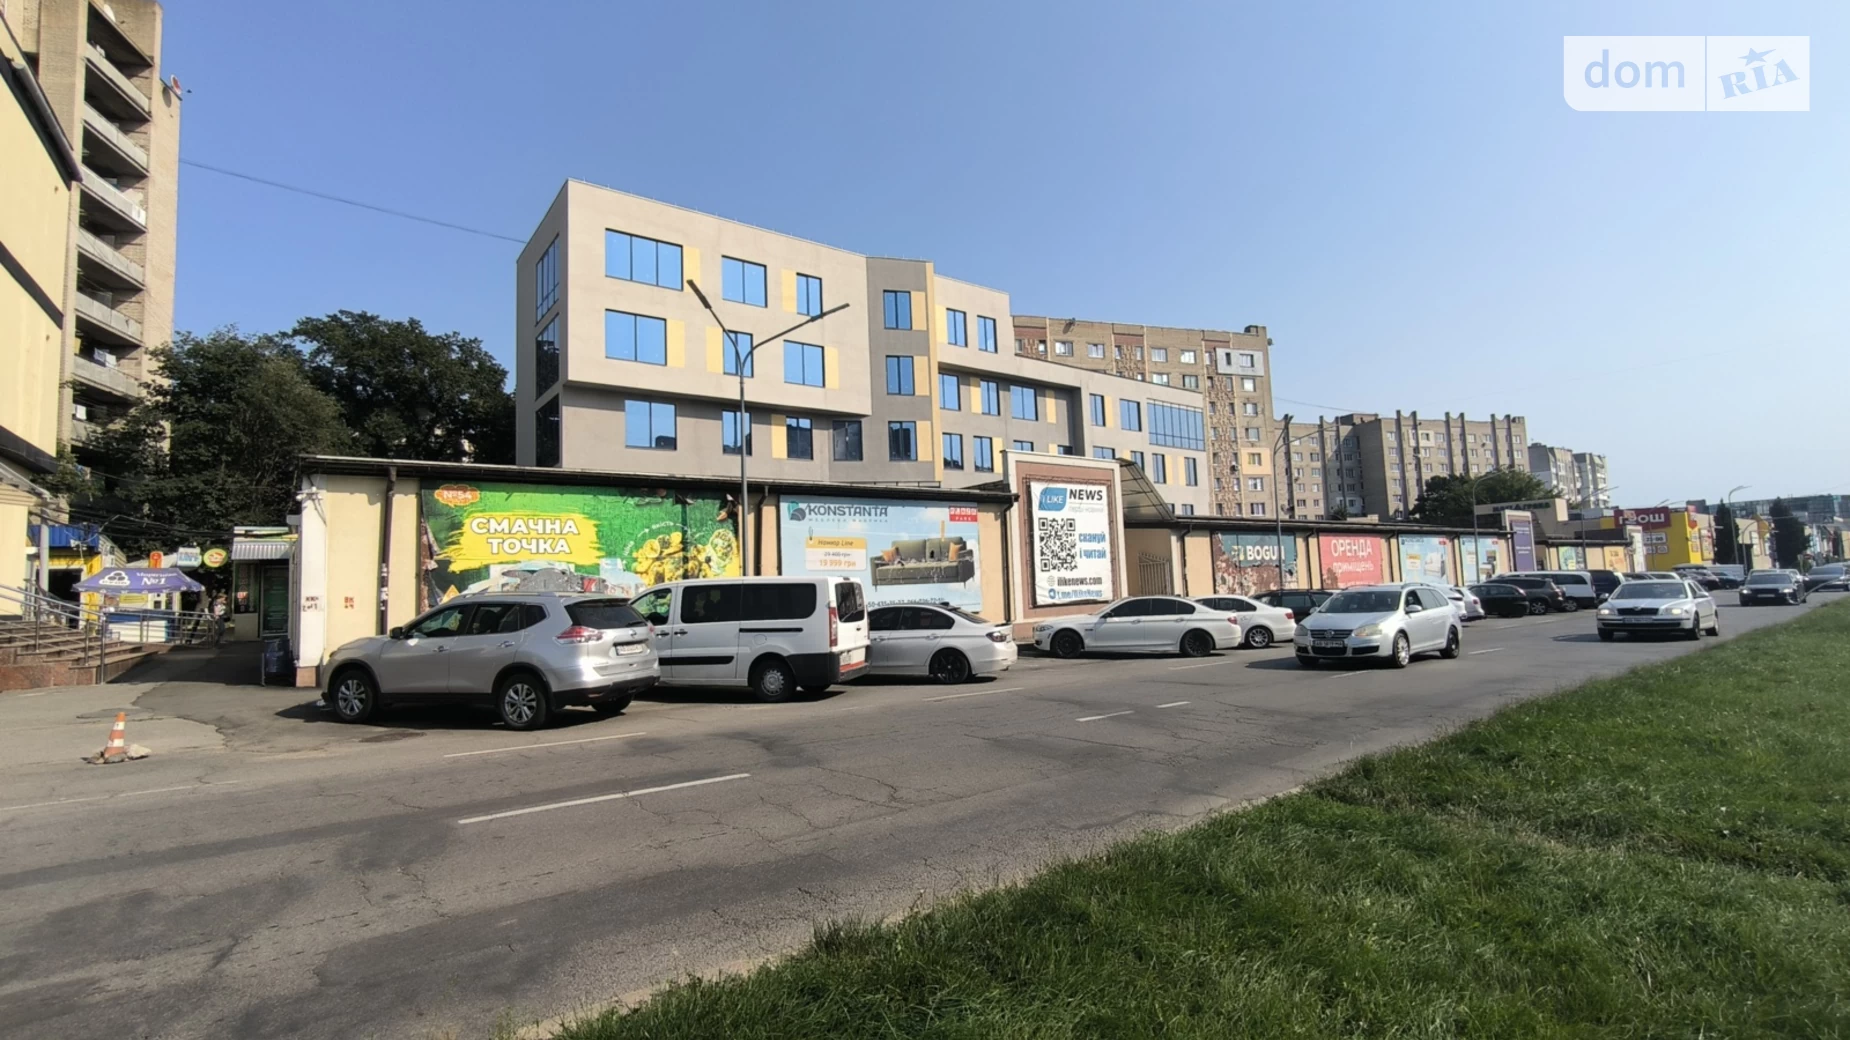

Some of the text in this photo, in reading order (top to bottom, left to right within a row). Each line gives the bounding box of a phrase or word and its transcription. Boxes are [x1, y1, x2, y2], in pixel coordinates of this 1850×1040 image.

[1046, 495, 1064, 504] LIKE
[1069, 488, 1103, 501] NEWS
[806, 504, 888, 517] KONSTANTA
[470, 516, 580, 536] СМАЧНА
[1078, 531, 1106, 543] скануй
[487, 537, 572, 555] ТОЧКА
[1331, 538, 1373, 557] ОРЕНДА
[1083, 547, 1107, 560] читай
[1057, 576, 1102, 587] ilikenews.com
